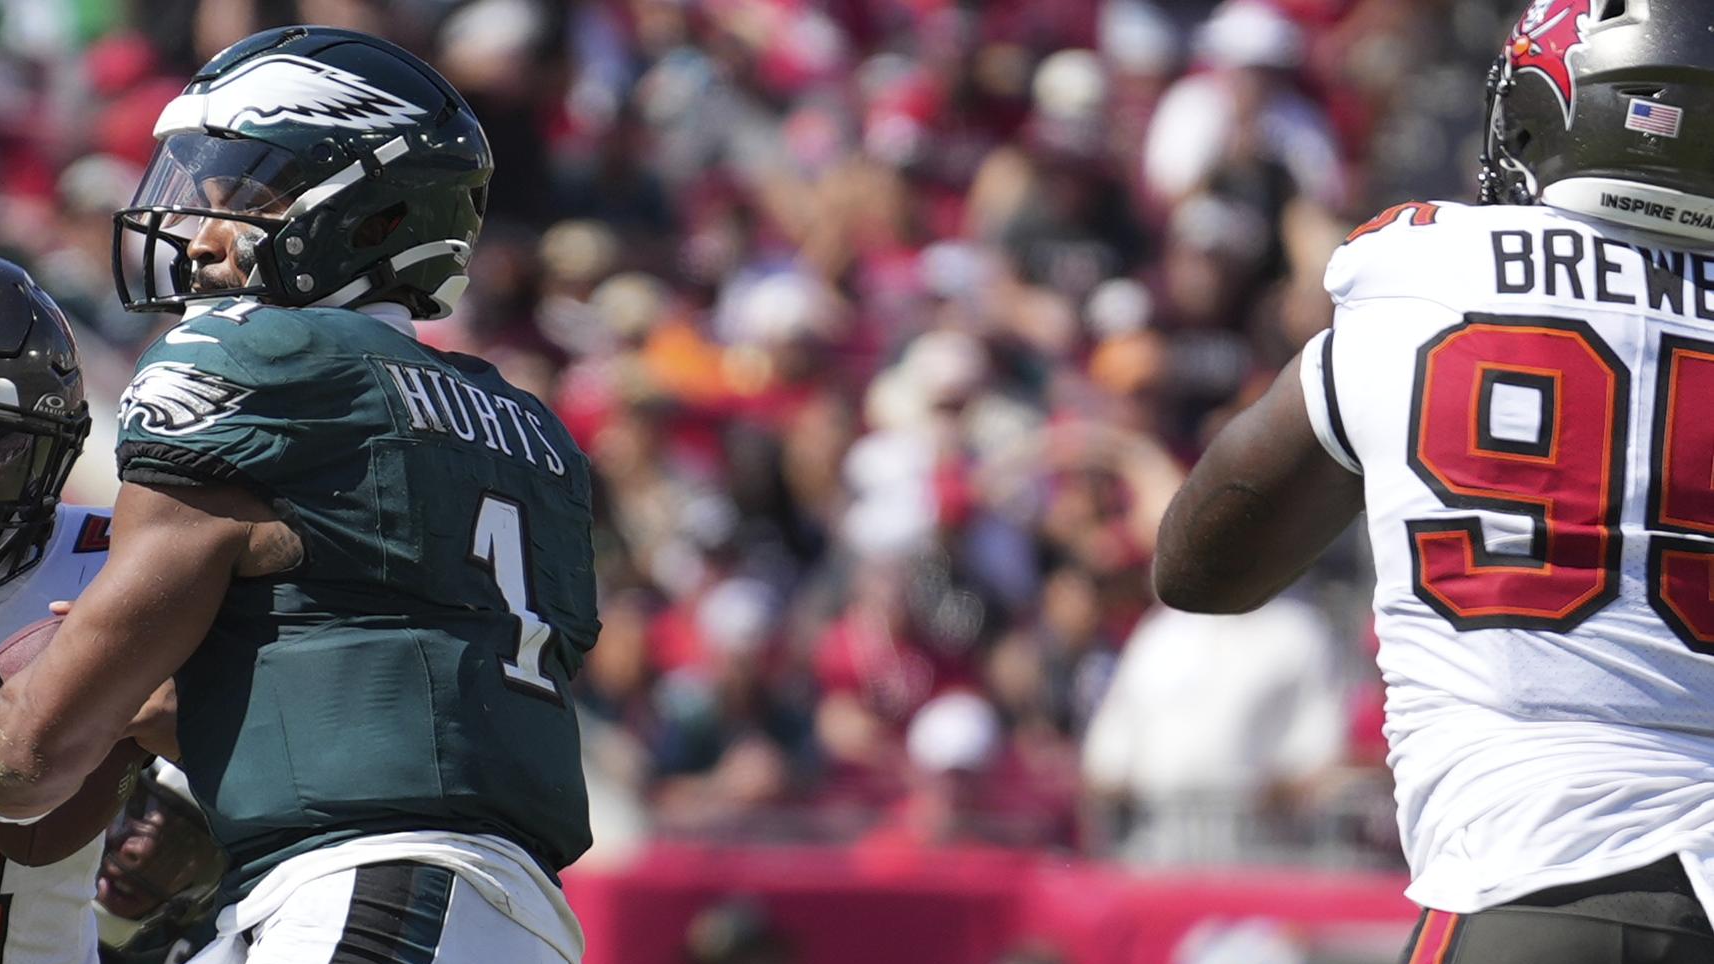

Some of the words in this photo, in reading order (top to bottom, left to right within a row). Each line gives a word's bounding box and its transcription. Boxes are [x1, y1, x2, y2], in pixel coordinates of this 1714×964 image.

[1601, 192, 1674, 221] INSPIRE
[387, 364, 565, 477] HURTS
[470, 491, 565, 706] 1
